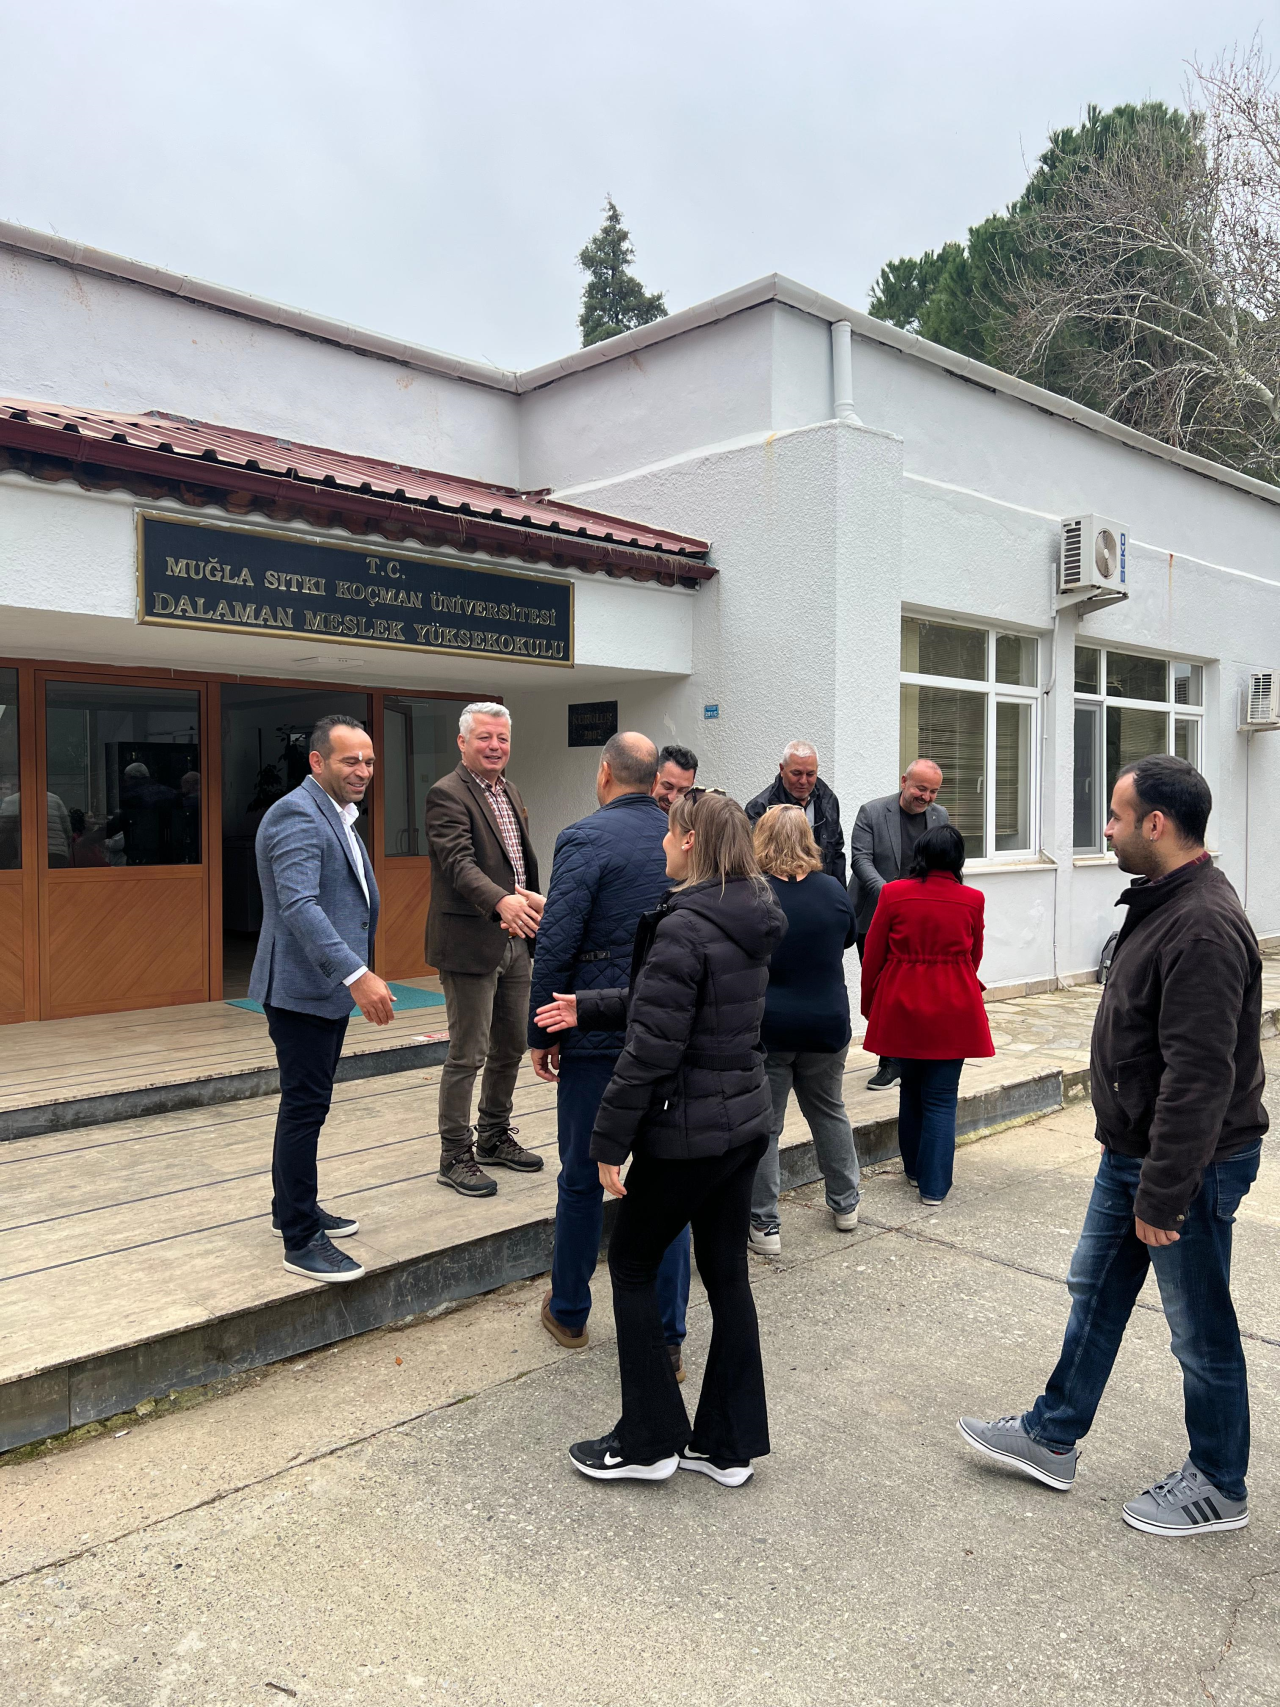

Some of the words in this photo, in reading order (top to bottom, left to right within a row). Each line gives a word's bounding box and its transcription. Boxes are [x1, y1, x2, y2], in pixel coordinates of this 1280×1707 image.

[166, 556, 254, 586] MUĞLA
[264, 570, 326, 596] SITKI
[335, 580, 423, 608] KOÇMAN
[430, 591, 557, 626] ÜNİVERSİTESİ
[366, 556, 406, 579] T.C.
[153, 592, 294, 628] DALAMAN
[304, 610, 406, 640] MESLEK
[413, 622, 565, 658] YÜKSEKOKULU
